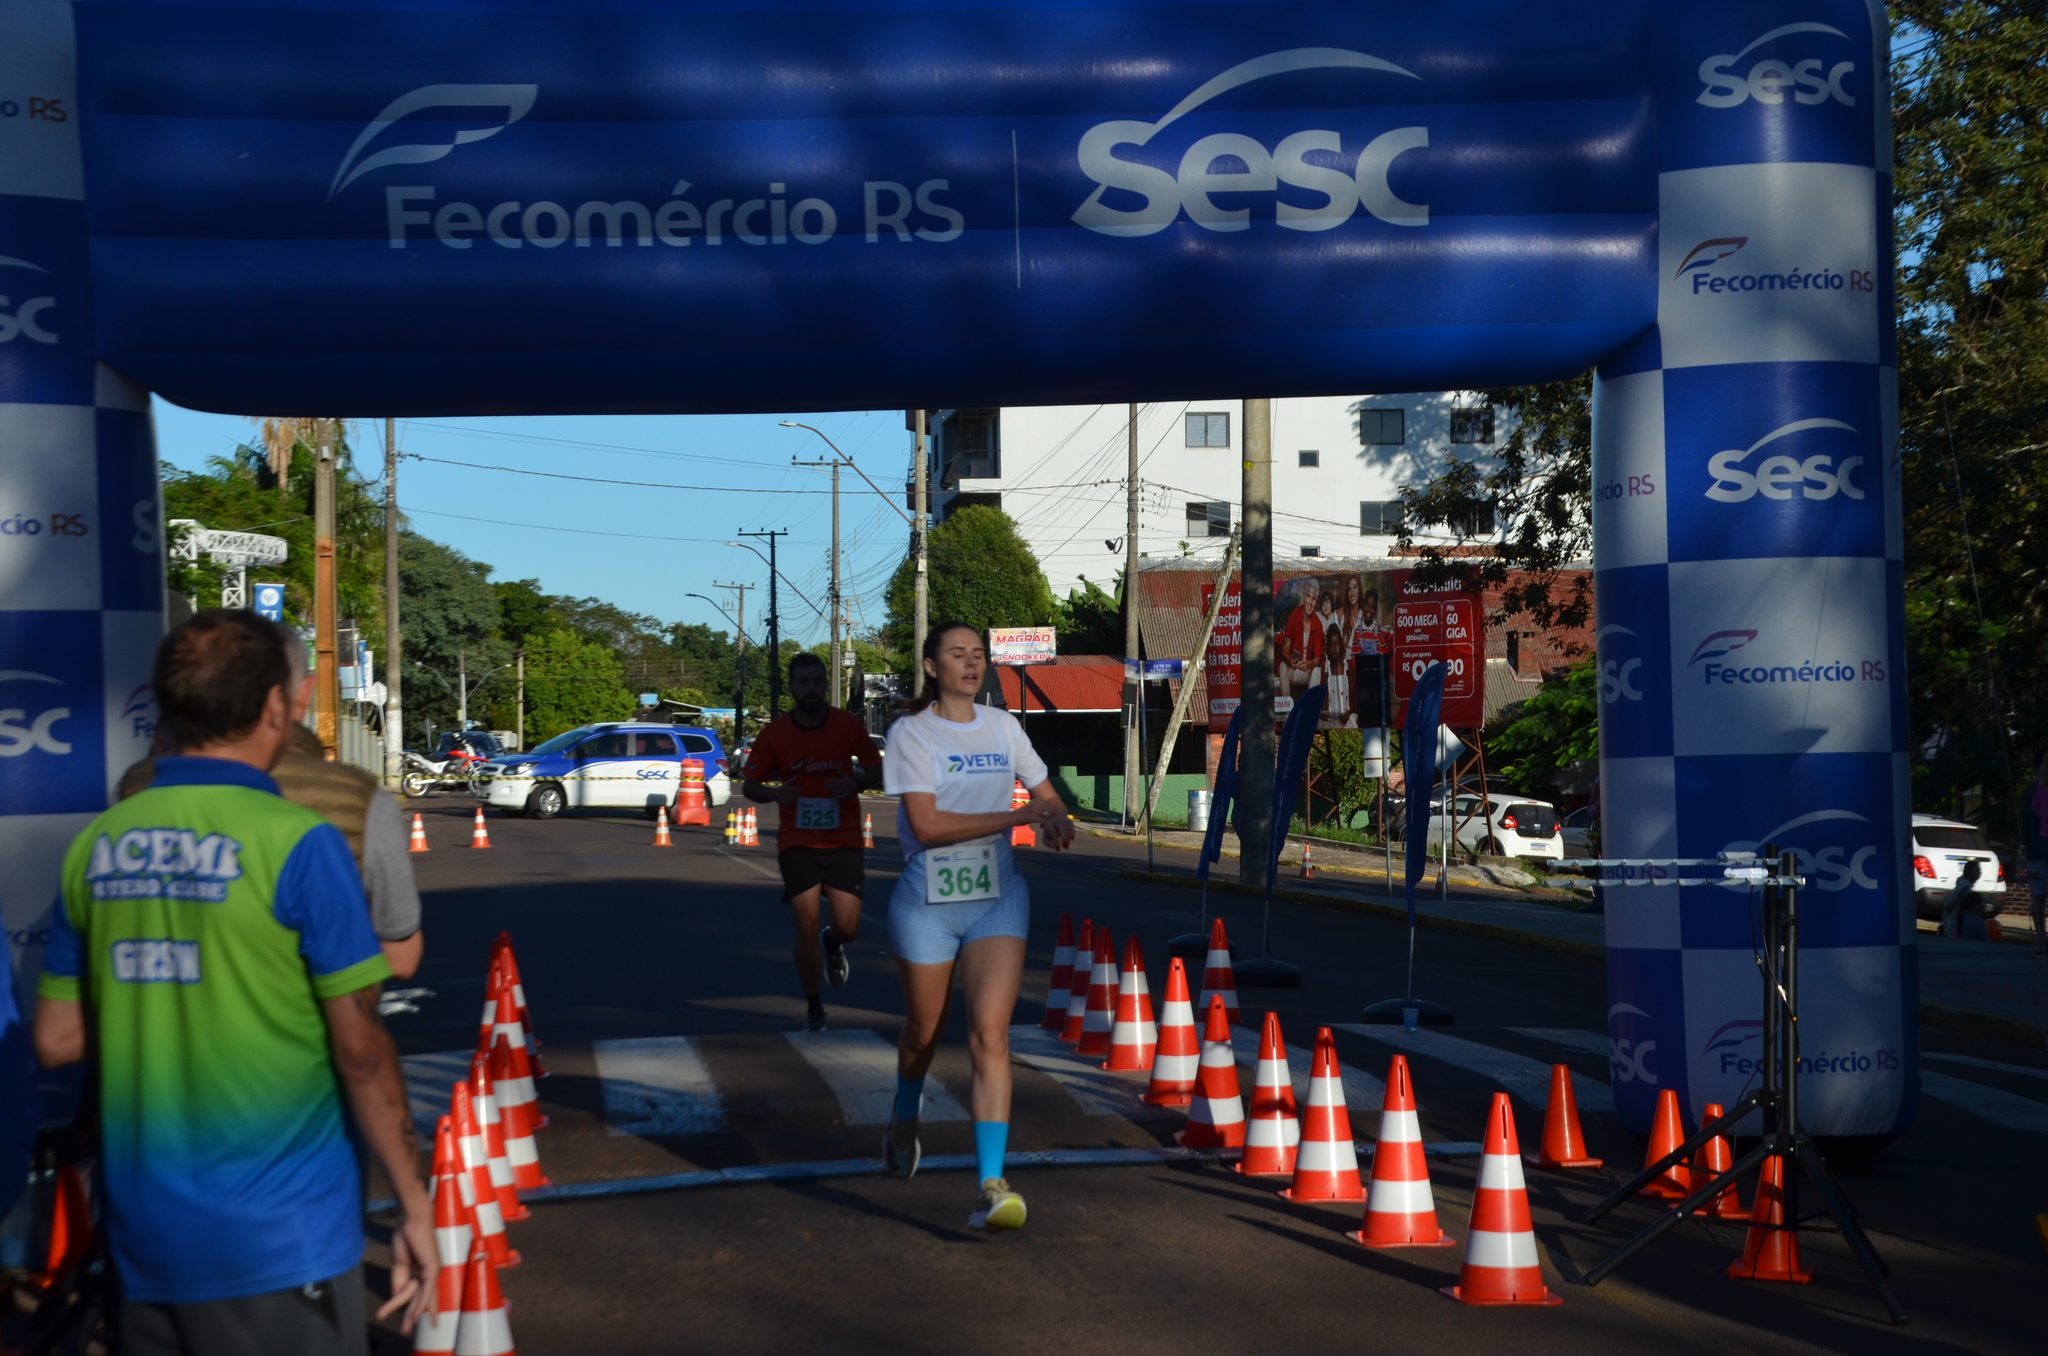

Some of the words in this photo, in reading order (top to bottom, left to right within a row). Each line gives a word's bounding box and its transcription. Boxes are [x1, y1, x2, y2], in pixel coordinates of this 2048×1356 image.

[1696, 53, 1856, 108] Sesc
[29, 97, 68, 123] RS
[1070, 118, 1430, 238] Sesc
[385, 178, 838, 249] Fecomércio
[863, 178, 966, 244] RS
[1692, 266, 1844, 295] Fecomércio
[1850, 268, 1874, 293] RS
[1628, 474, 1655, 497] RS
[1704, 449, 1865, 503] Sesc
[50, 513, 89, 538] RS
[1397, 615, 1413, 628] 600
[1414, 614, 1438, 627] MEGA
[1446, 612, 1459, 625] 60
[996, 631, 1051, 643] MAGRÃO
[1208, 631, 1231, 647] Claro
[1446, 627, 1467, 639] GIGA
[1002, 653, 1046, 661] SNOOKER
[1208, 650, 1217, 665] tá
[1218, 654, 1229, 665] na
[1229, 652, 1241, 665] su
[1402, 661, 1411, 672] R$
[1209, 668, 1238, 685] cidade.
[1704, 660, 1856, 685] Fecomércio
[1861, 660, 1885, 682] RS
[636, 769, 671, 781] Sesc
[802, 809, 835, 827] 525
[937, 864, 991, 897] 364
[1877, 1048, 1900, 1071] RS
